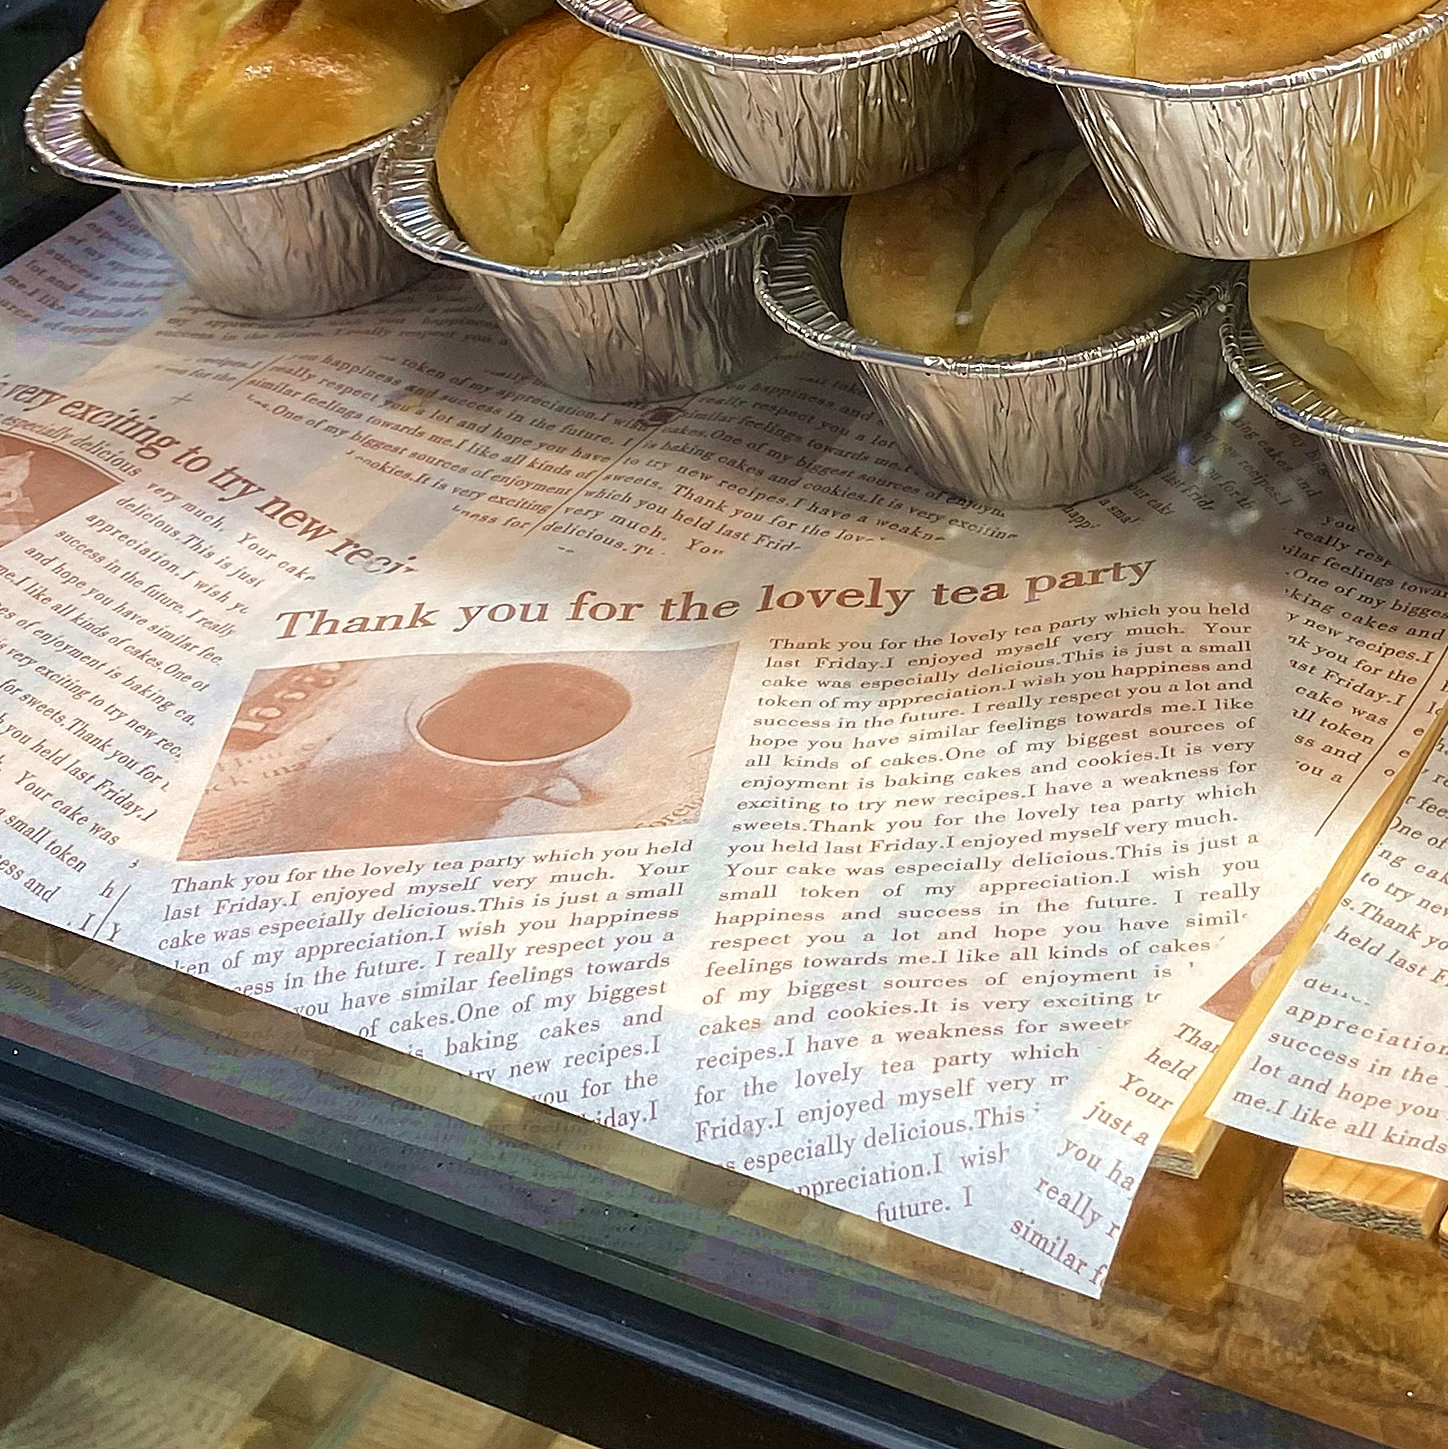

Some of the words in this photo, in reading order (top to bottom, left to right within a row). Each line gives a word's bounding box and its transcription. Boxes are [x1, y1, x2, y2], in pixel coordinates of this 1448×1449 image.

[2, 384, 67, 412] very
[58, 400, 181, 460] exciting
[207, 466, 266, 502] try
[254, 495, 338, 542] new
[275, 602, 440, 639] Thank
[453, 603, 549, 632] you
[565, 591, 644, 621] for
[660, 591, 740, 621] the
[755, 577, 916, 617] lovely
[931, 583, 1009, 606] tea
[1024, 560, 1156, 604] party
[766, 657, 799, 668] last
[908, 648, 982, 668] enjoyed
[996, 636, 1061, 657] myself
[1072, 631, 1113, 644] very
[1203, 622, 1251, 634] Your
[770, 638, 830, 649] Thank
[837, 641, 872, 652] you
[879, 638, 907, 650] for
[914, 635, 943, 648] the
[950, 629, 1007, 644] lovely
[1015, 625, 1042, 636] tea
[1049, 616, 1097, 633] party
[1104, 604, 1160, 621] which
[1167, 606, 1201, 618] you
[1209, 602, 1250, 615] held
[104, 750, 141, 771] you
[136, 765, 163, 784] for
[741, 775, 848, 791] enjoyment
[857, 777, 874, 790] is
[884, 772, 955, 788] baking
[964, 766, 1021, 781] cakes
[1031, 757, 1067, 774] and
[1186, 742, 1202, 756] is
[1212, 742, 1255, 753] very
[14, 770, 54, 801] Your
[51, 800, 89, 825] cake
[89, 822, 120, 845] was
[171, 873, 237, 894] Thank
[241, 874, 280, 891] you
[286, 868, 317, 883] for
[323, 865, 355, 879] the
[361, 860, 426, 876] lovely
[433, 861, 463, 871] tea
[469, 855, 526, 873] party
[533, 847, 594, 863] which
[601, 848, 639, 862] you
[645, 839, 693, 855] held
[1360, 871, 1380, 888] to
[1384, 882, 1415, 901] try
[162, 904, 201, 922] last
[312, 882, 395, 906] enjoyed
[407, 876, 482, 897] myself
[492, 876, 538, 890] very
[637, 863, 690, 877] Your
[512, 993, 538, 1013] of
[543, 994, 576, 1012] my
[587, 980, 667, 1005] biggest
[806, 1035, 858, 1053] have
[871, 1034, 884, 1045] a
[896, 1023, 1003, 1043] weakness
[1015, 1019, 1049, 1034] for
[1144, 1047, 1197, 1081] held
[1119, 1072, 1173, 1110] Your
[1082, 1105, 1132, 1135] just
[1290, 1103, 1337, 1129] like
[1344, 1121, 1377, 1139] all
[1381, 1126, 1448, 1154] kinds
[1034, 1177, 1103, 1229] really
[1010, 1219, 1088, 1275] similar
